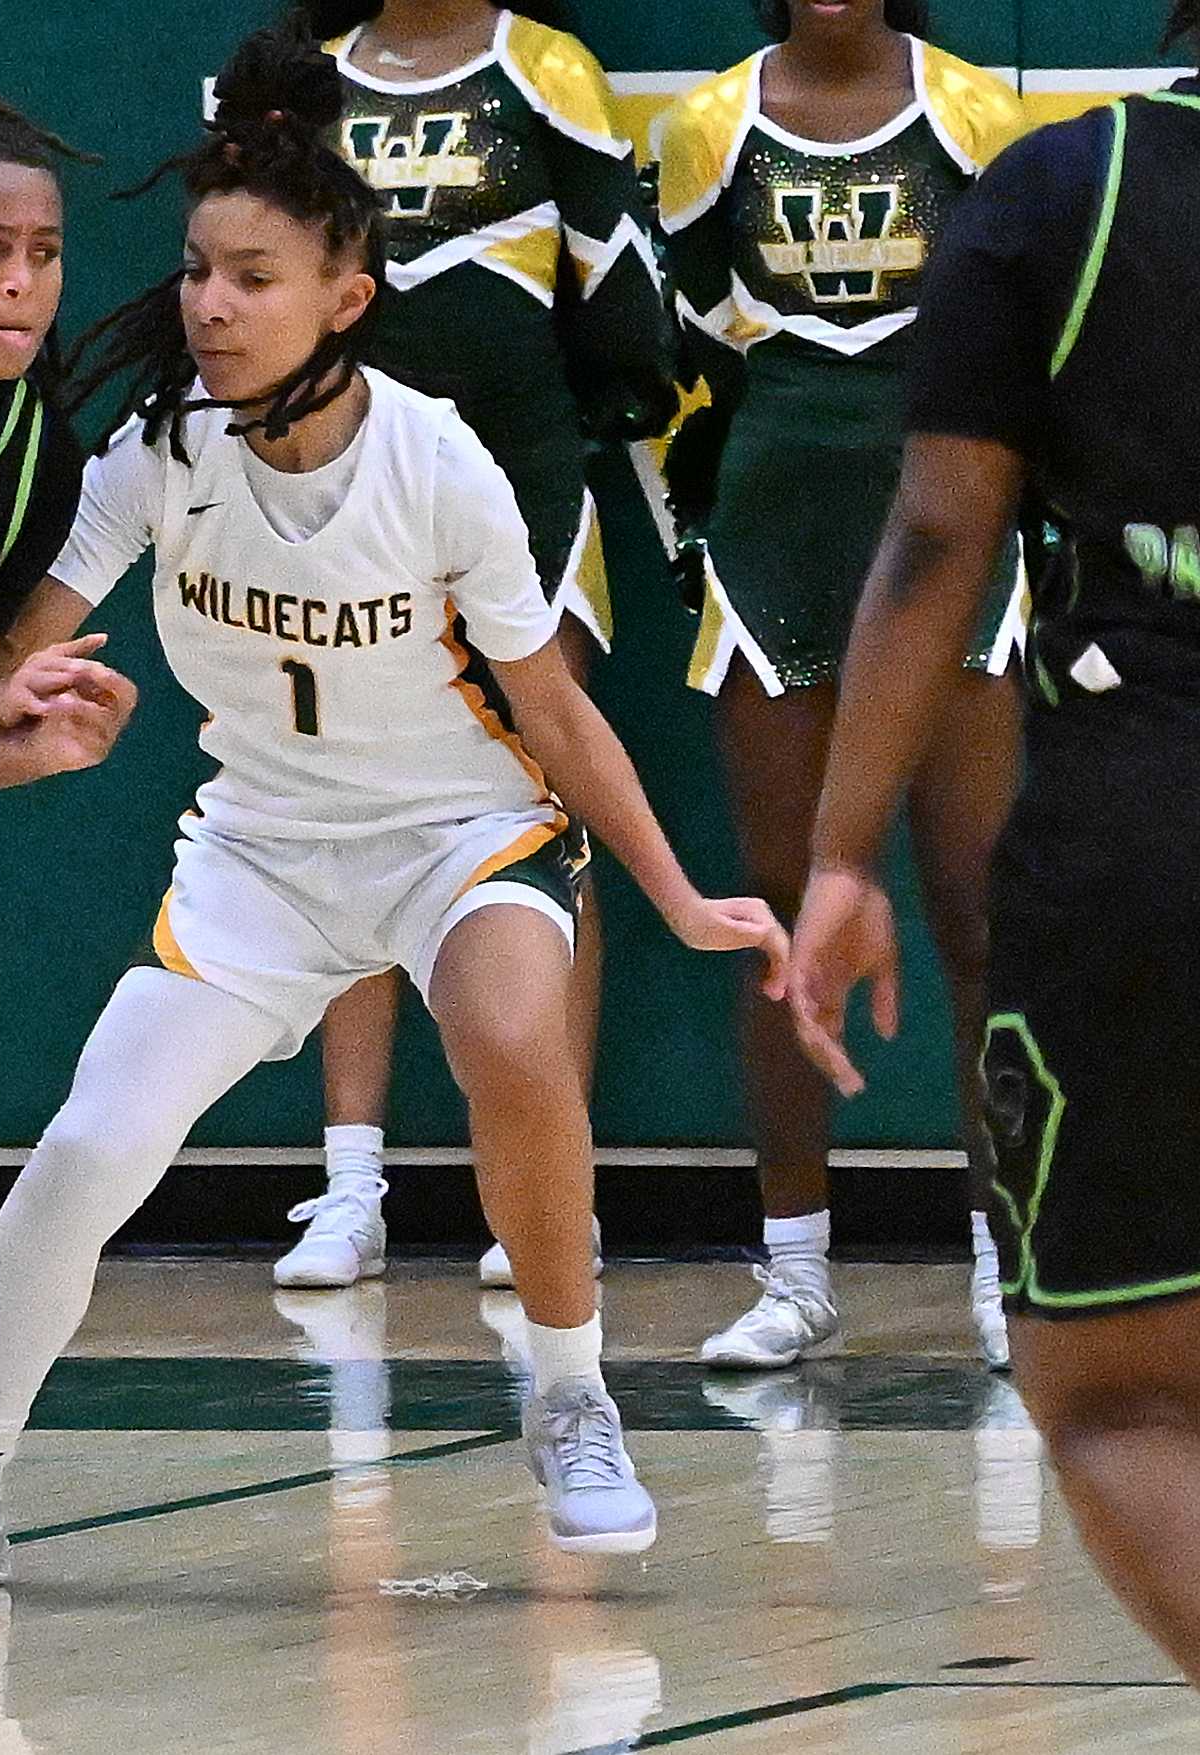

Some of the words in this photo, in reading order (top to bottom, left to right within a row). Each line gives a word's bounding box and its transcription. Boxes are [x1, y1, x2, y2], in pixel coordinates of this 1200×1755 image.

[773, 184, 899, 303] W
[177, 571, 412, 648] WILDECATS
[280, 658, 318, 736] 1
